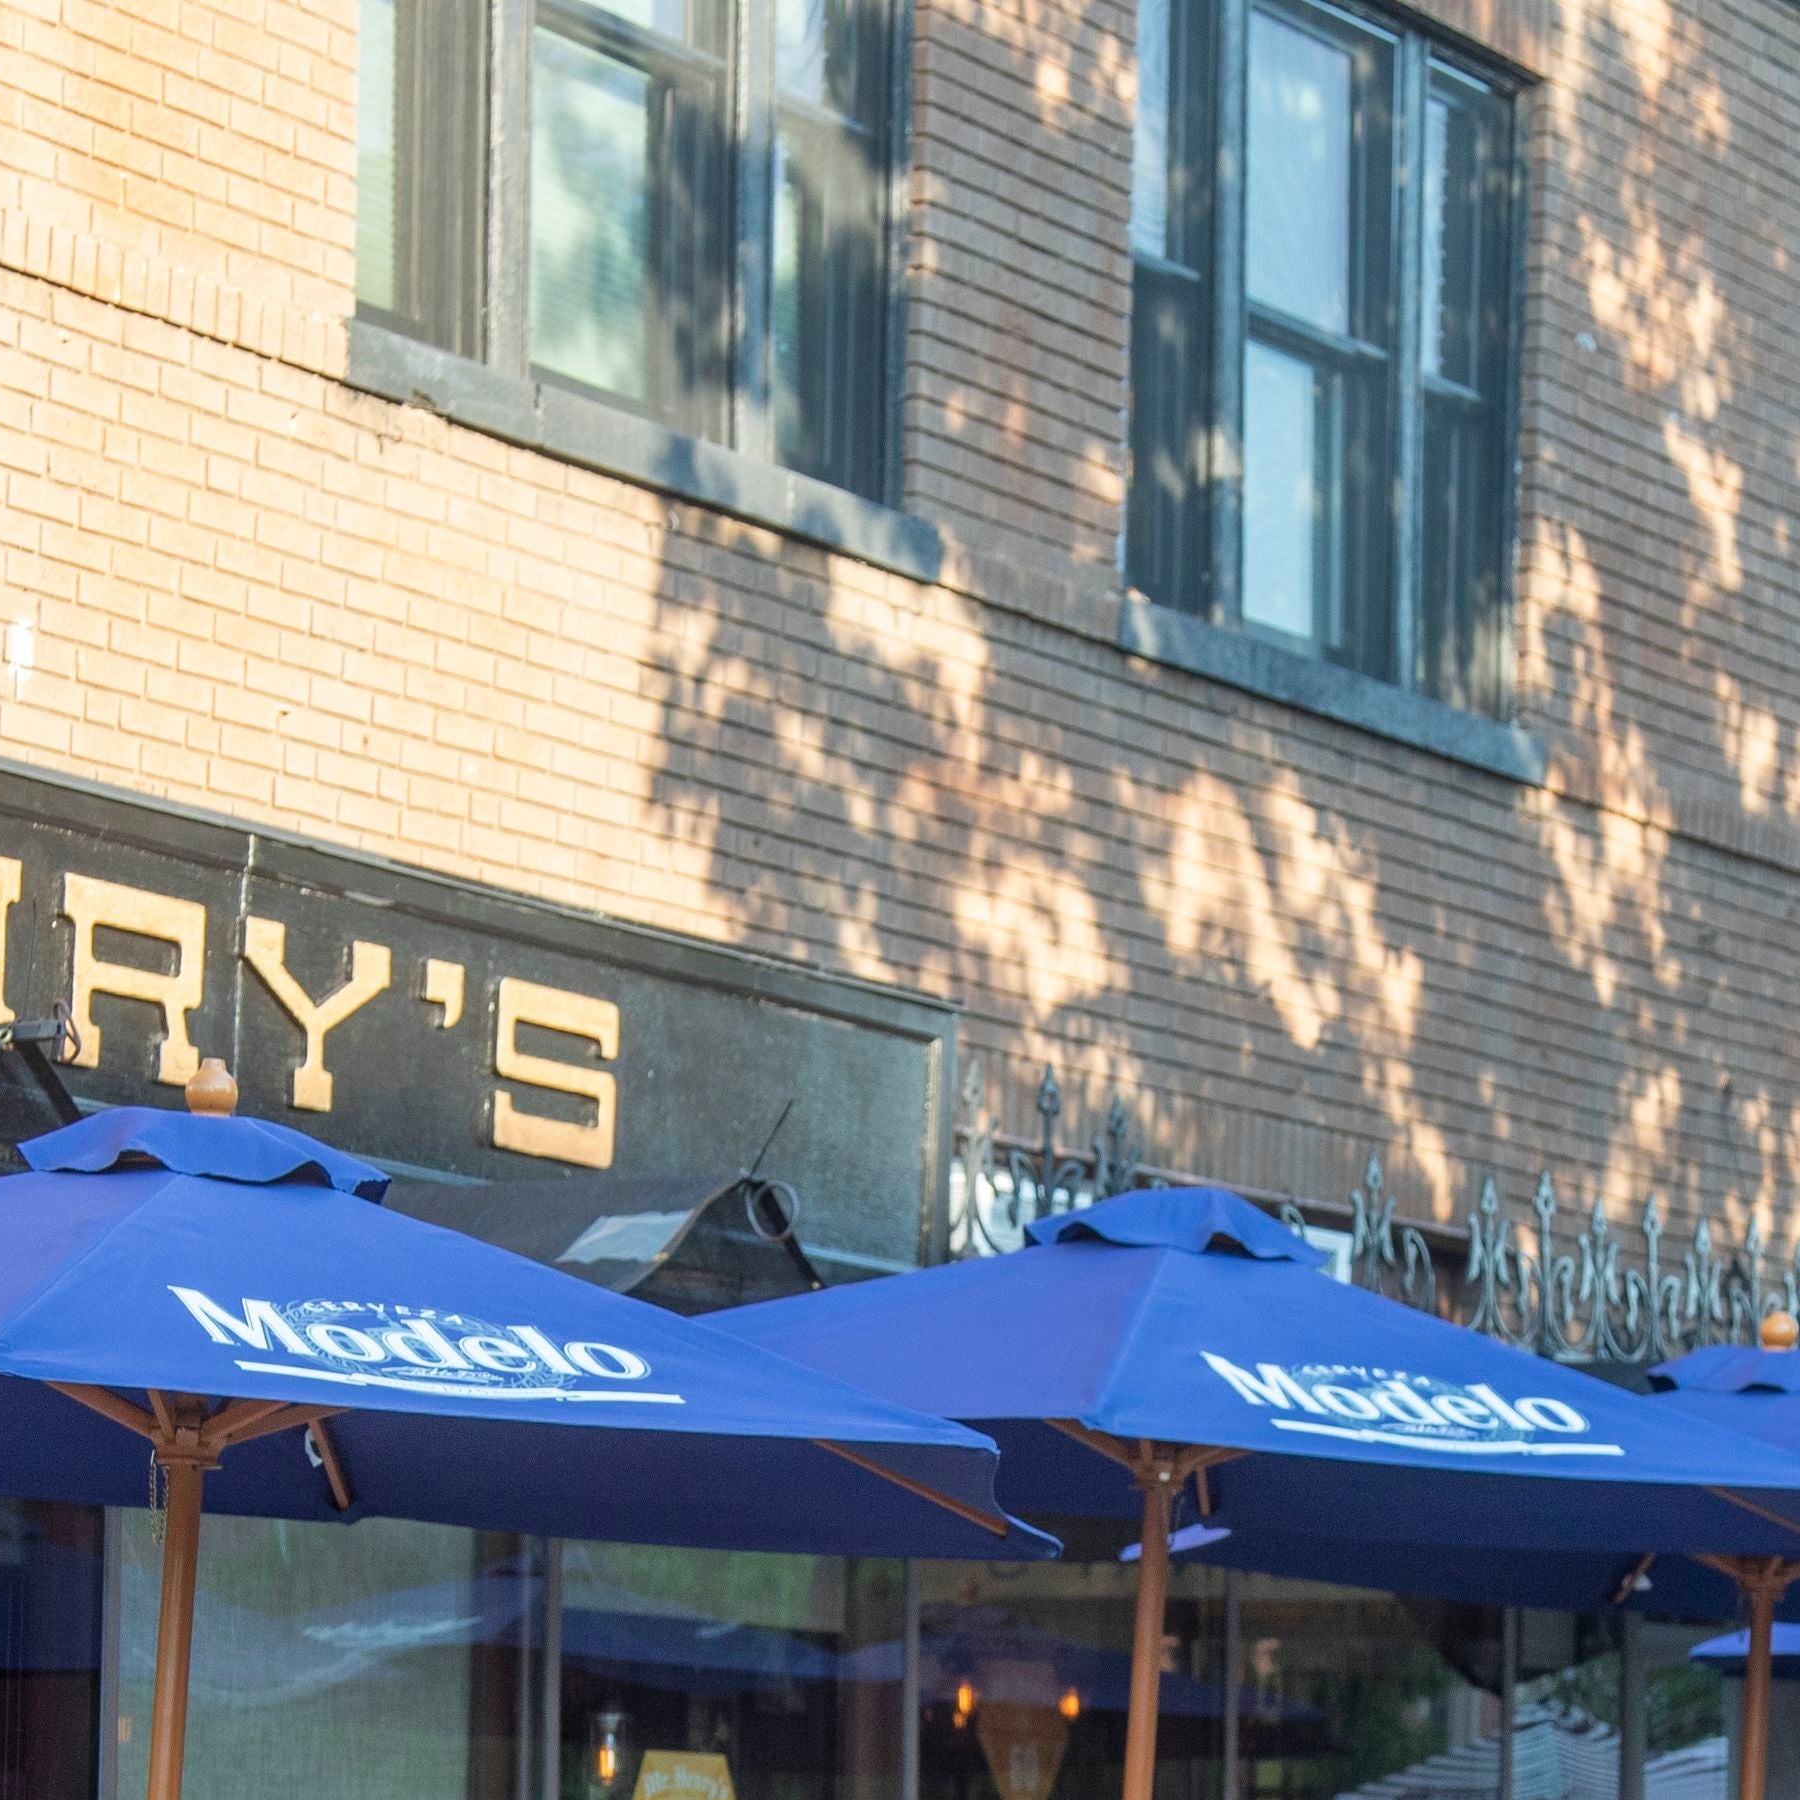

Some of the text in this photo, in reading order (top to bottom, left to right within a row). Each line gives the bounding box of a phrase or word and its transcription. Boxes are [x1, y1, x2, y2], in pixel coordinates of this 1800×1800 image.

[167, 1284, 652, 1381] Modelo
[302, 1300, 462, 1325] CERVEZA
[1200, 1350, 1571, 1434] Modelo
